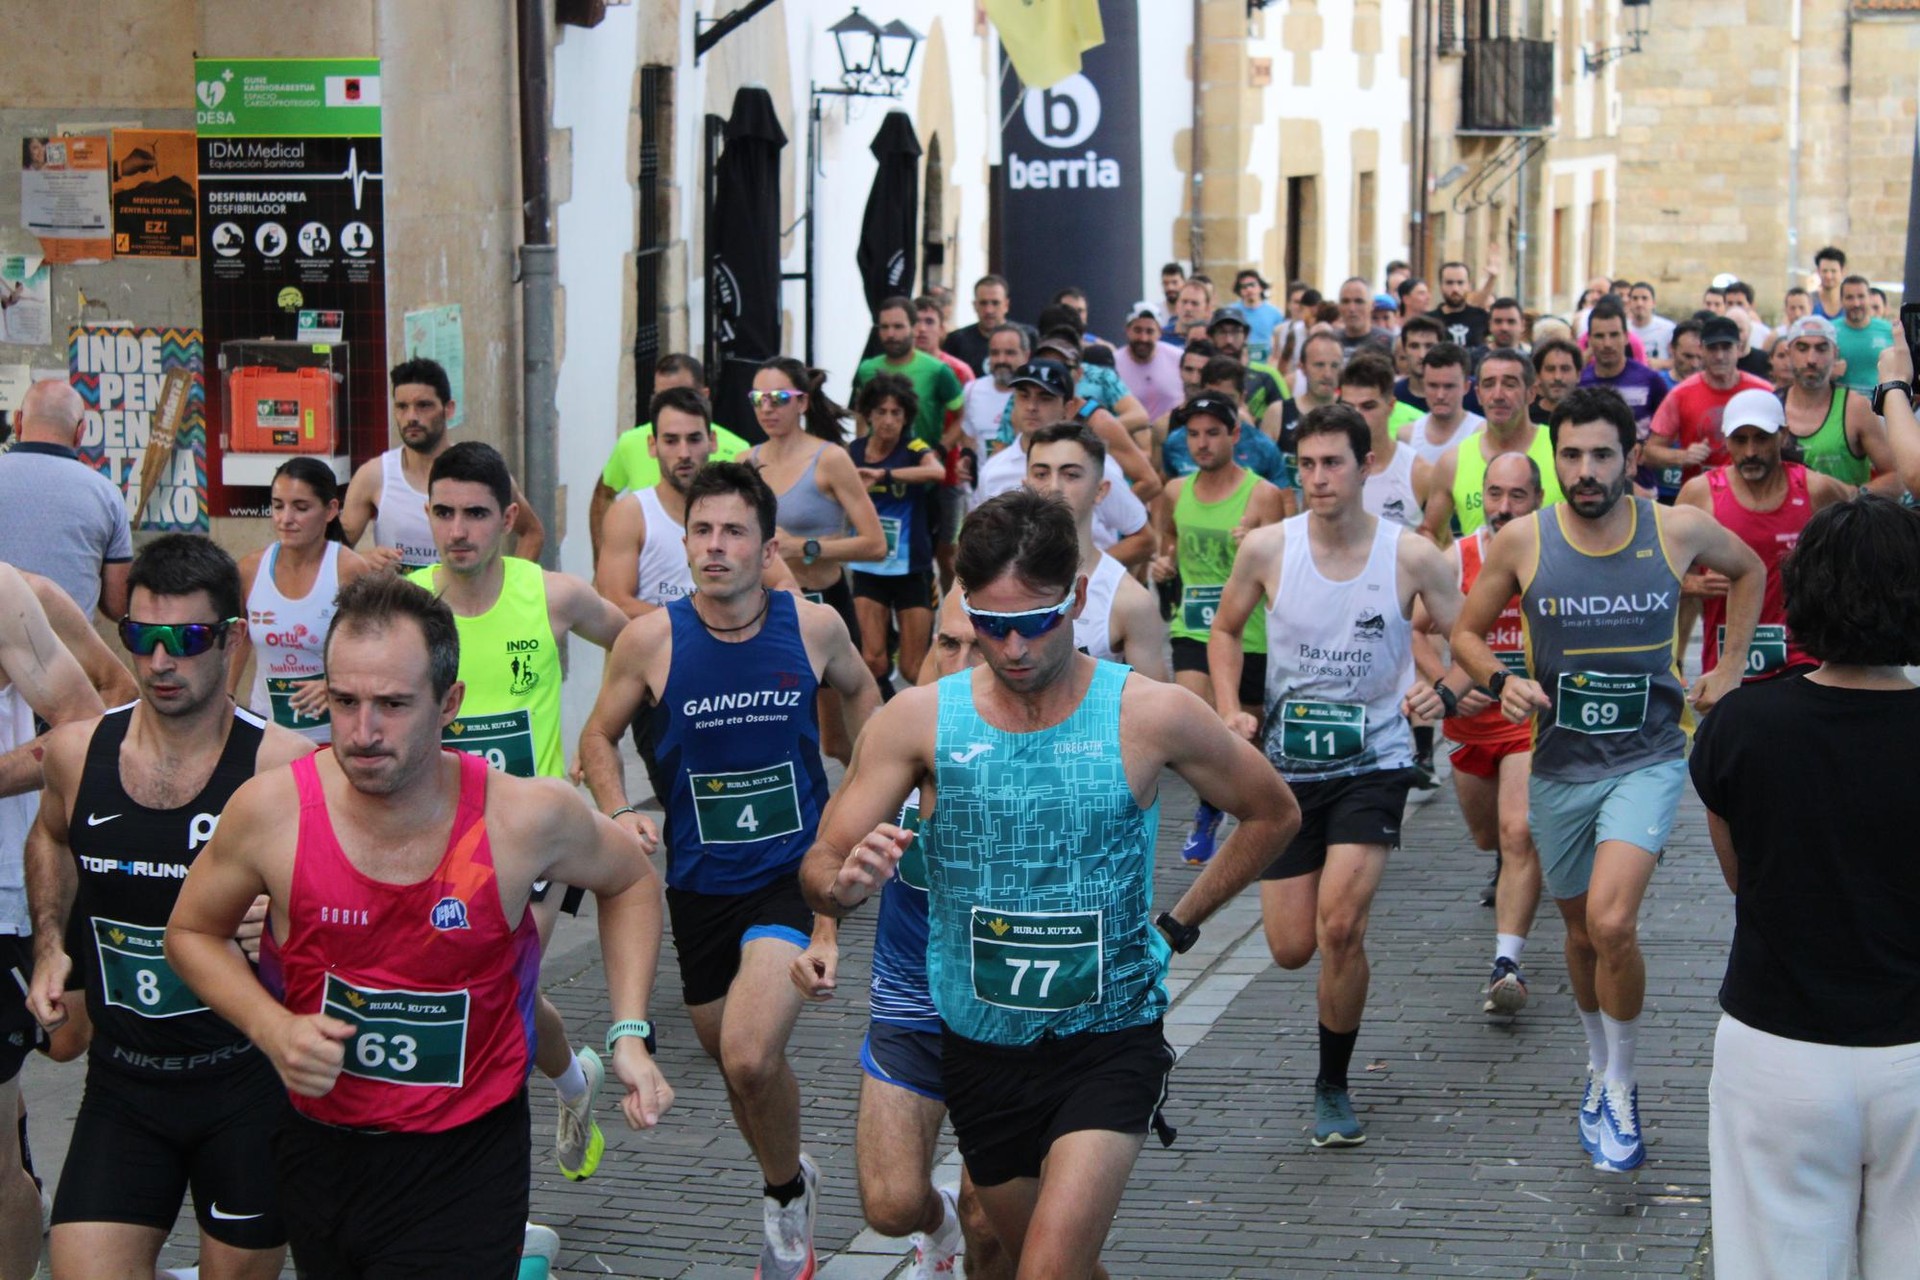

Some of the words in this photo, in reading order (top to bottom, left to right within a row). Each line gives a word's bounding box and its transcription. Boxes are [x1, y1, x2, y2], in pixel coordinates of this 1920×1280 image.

[196, 112, 235, 124] DESA
[209, 142, 243, 158] IDM
[248, 142, 304, 158] Medical
[209, 159, 261, 169] Equipación
[264, 159, 304, 168] Sanitaria
[1009, 150, 1121, 189] berria
[209, 192, 307, 202] DESFIBRILADOREA
[209, 204, 287, 215] DESFIBRILADOR
[145, 221, 167, 233] EZ!
[77, 335, 162, 373] INDE
[100, 373, 167, 411] PEN
[80, 411, 151, 448] DEN
[1559, 592, 1670, 616] INDAUX
[1562, 618, 1591, 628] Smart
[1596, 616, 1645, 627] Simplicity
[506, 639, 539, 652] INDO
[1299, 644, 1372, 663] Baxurde
[1745, 650, 1765, 671] 0
[683, 691, 801, 716] GAINDITUZ
[695, 718, 724, 730] Kirola
[726, 716, 743, 725] eta
[745, 713, 789, 723] Osasuna
[1581, 702, 1619, 726] 69
[467, 724, 491, 732] RURAL
[1304, 730, 1336, 755] 11
[467, 748, 507, 773] 9
[726, 780, 752, 789] RURAL
[736, 804, 759, 832] 4
[321, 906, 369, 925] GOBIK
[1013, 926, 1045, 935] RURAL
[1047, 925, 1082, 935] KUTXA
[127, 936, 153, 947] RURAL
[136, 969, 161, 1006] 8
[1005, 958, 1061, 998] 77
[369, 1002, 405, 1011] RURAL
[407, 1004, 447, 1013] KUTXA
[112, 1046, 185, 1070] NIKE
[356, 1032, 418, 1072] 63
